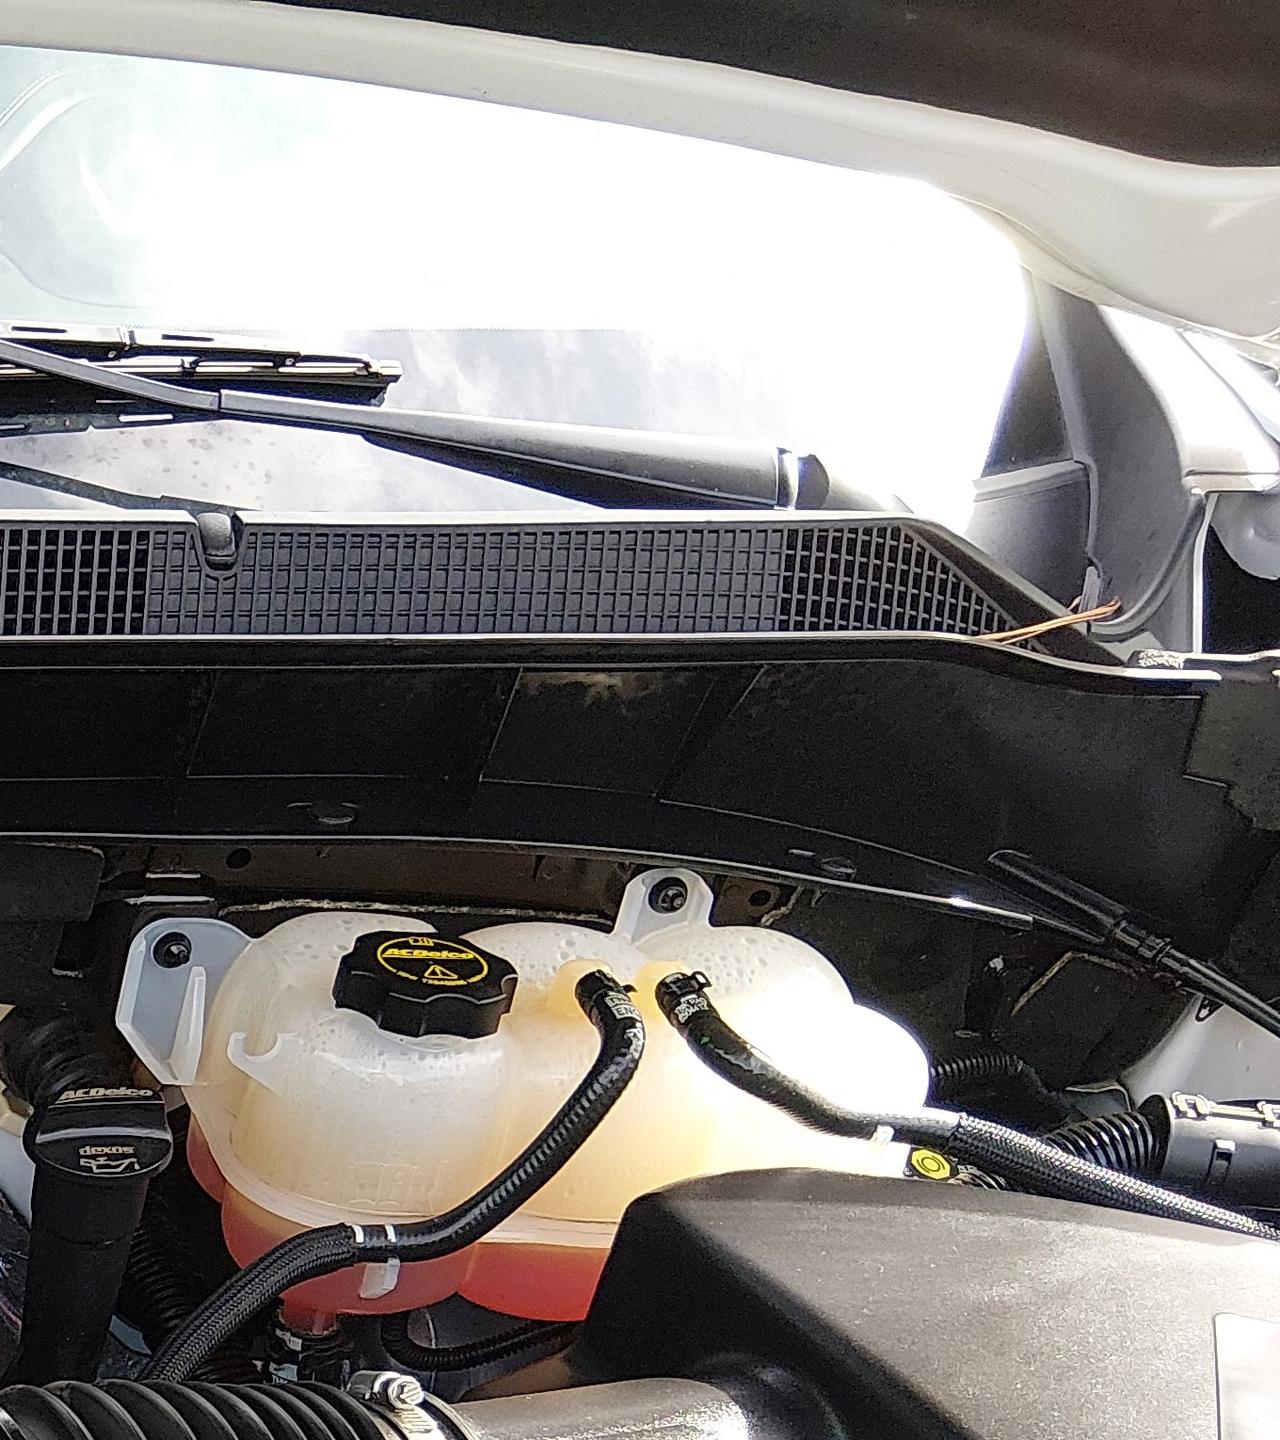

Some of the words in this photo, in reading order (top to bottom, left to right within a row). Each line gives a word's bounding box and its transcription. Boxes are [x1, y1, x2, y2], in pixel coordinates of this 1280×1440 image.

[382, 948, 475, 960] ACDelco
[57, 1087, 154, 1101] ACDelco
[79, 1145, 135, 1156] dexos
